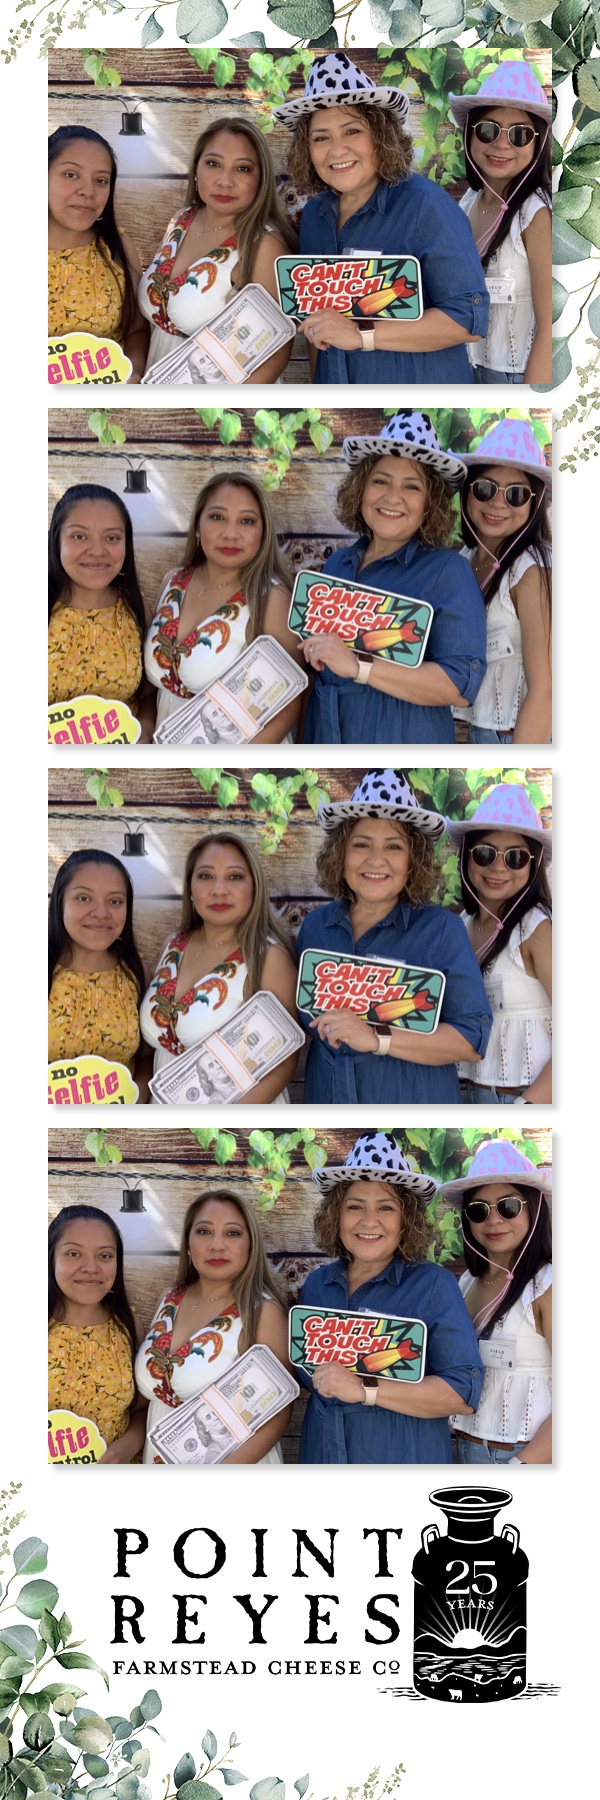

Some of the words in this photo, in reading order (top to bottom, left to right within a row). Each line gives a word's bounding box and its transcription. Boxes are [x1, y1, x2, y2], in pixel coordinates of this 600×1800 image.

[291, 261, 368, 283] CAN'T
[296, 277, 382, 298] TOUCH
[299, 295, 352, 313] THIS
[308, 584, 384, 609] CAN'T
[306, 601, 394, 630] TOUCH
[303, 615, 357, 641] THIS
[48, 708, 75, 724] no
[48, 709, 119, 744] elfie
[315, 961, 395, 983] CAN'T
[315, 978, 406, 1001] TOUCH
[313, 993, 370, 1014] THIS
[51, 1067, 78, 1080] no
[48, 1071, 119, 1104] elfie
[303, 1316, 378, 1336] CAN'T
[305, 1333, 391, 1353] TOUCH
[305, 1347, 358, 1366] THIS
